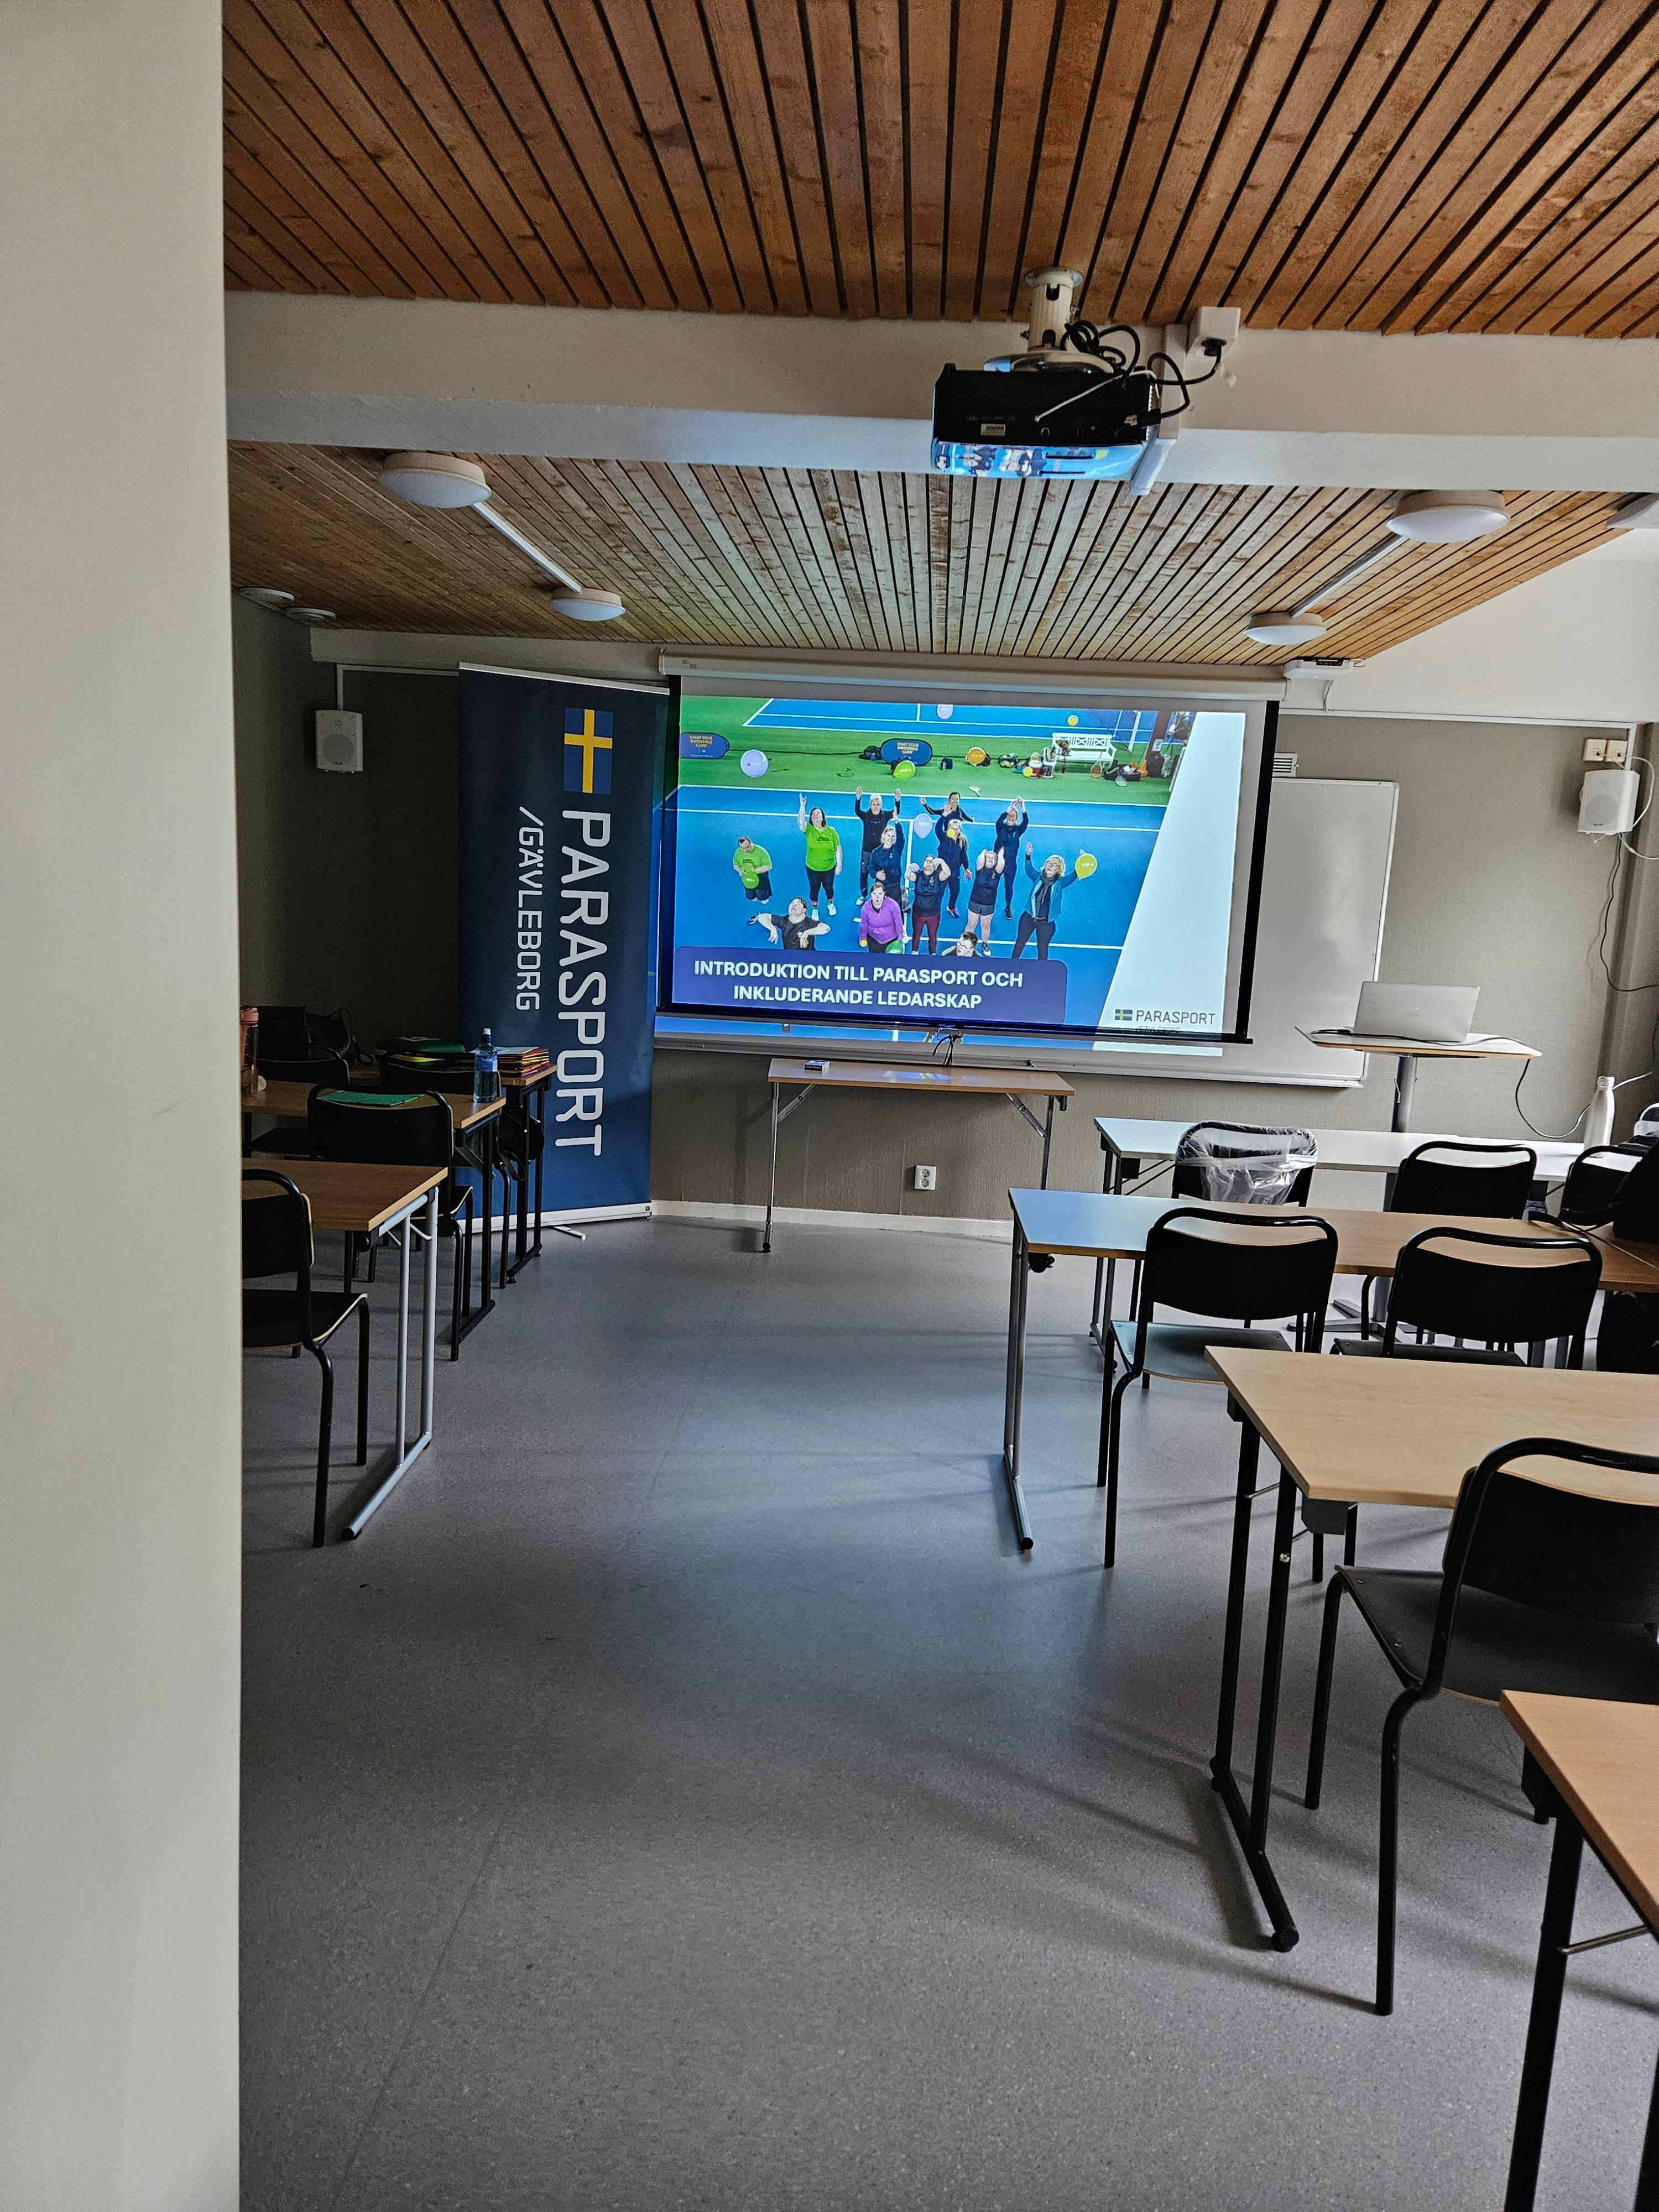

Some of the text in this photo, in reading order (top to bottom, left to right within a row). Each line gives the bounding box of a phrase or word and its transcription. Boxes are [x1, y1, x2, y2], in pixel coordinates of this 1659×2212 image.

[516, 806, 544, 1010] /GÄVLEBORG
[555, 810, 611, 1156] PARASPORT
[694, 960, 1023, 987] INTRODUKTION TILL PARASPORT OCH
[733, 985, 982, 1009] INKLUDERANDE LEDARSKAP
[1136, 1010, 1216, 1025] PARASPORT
